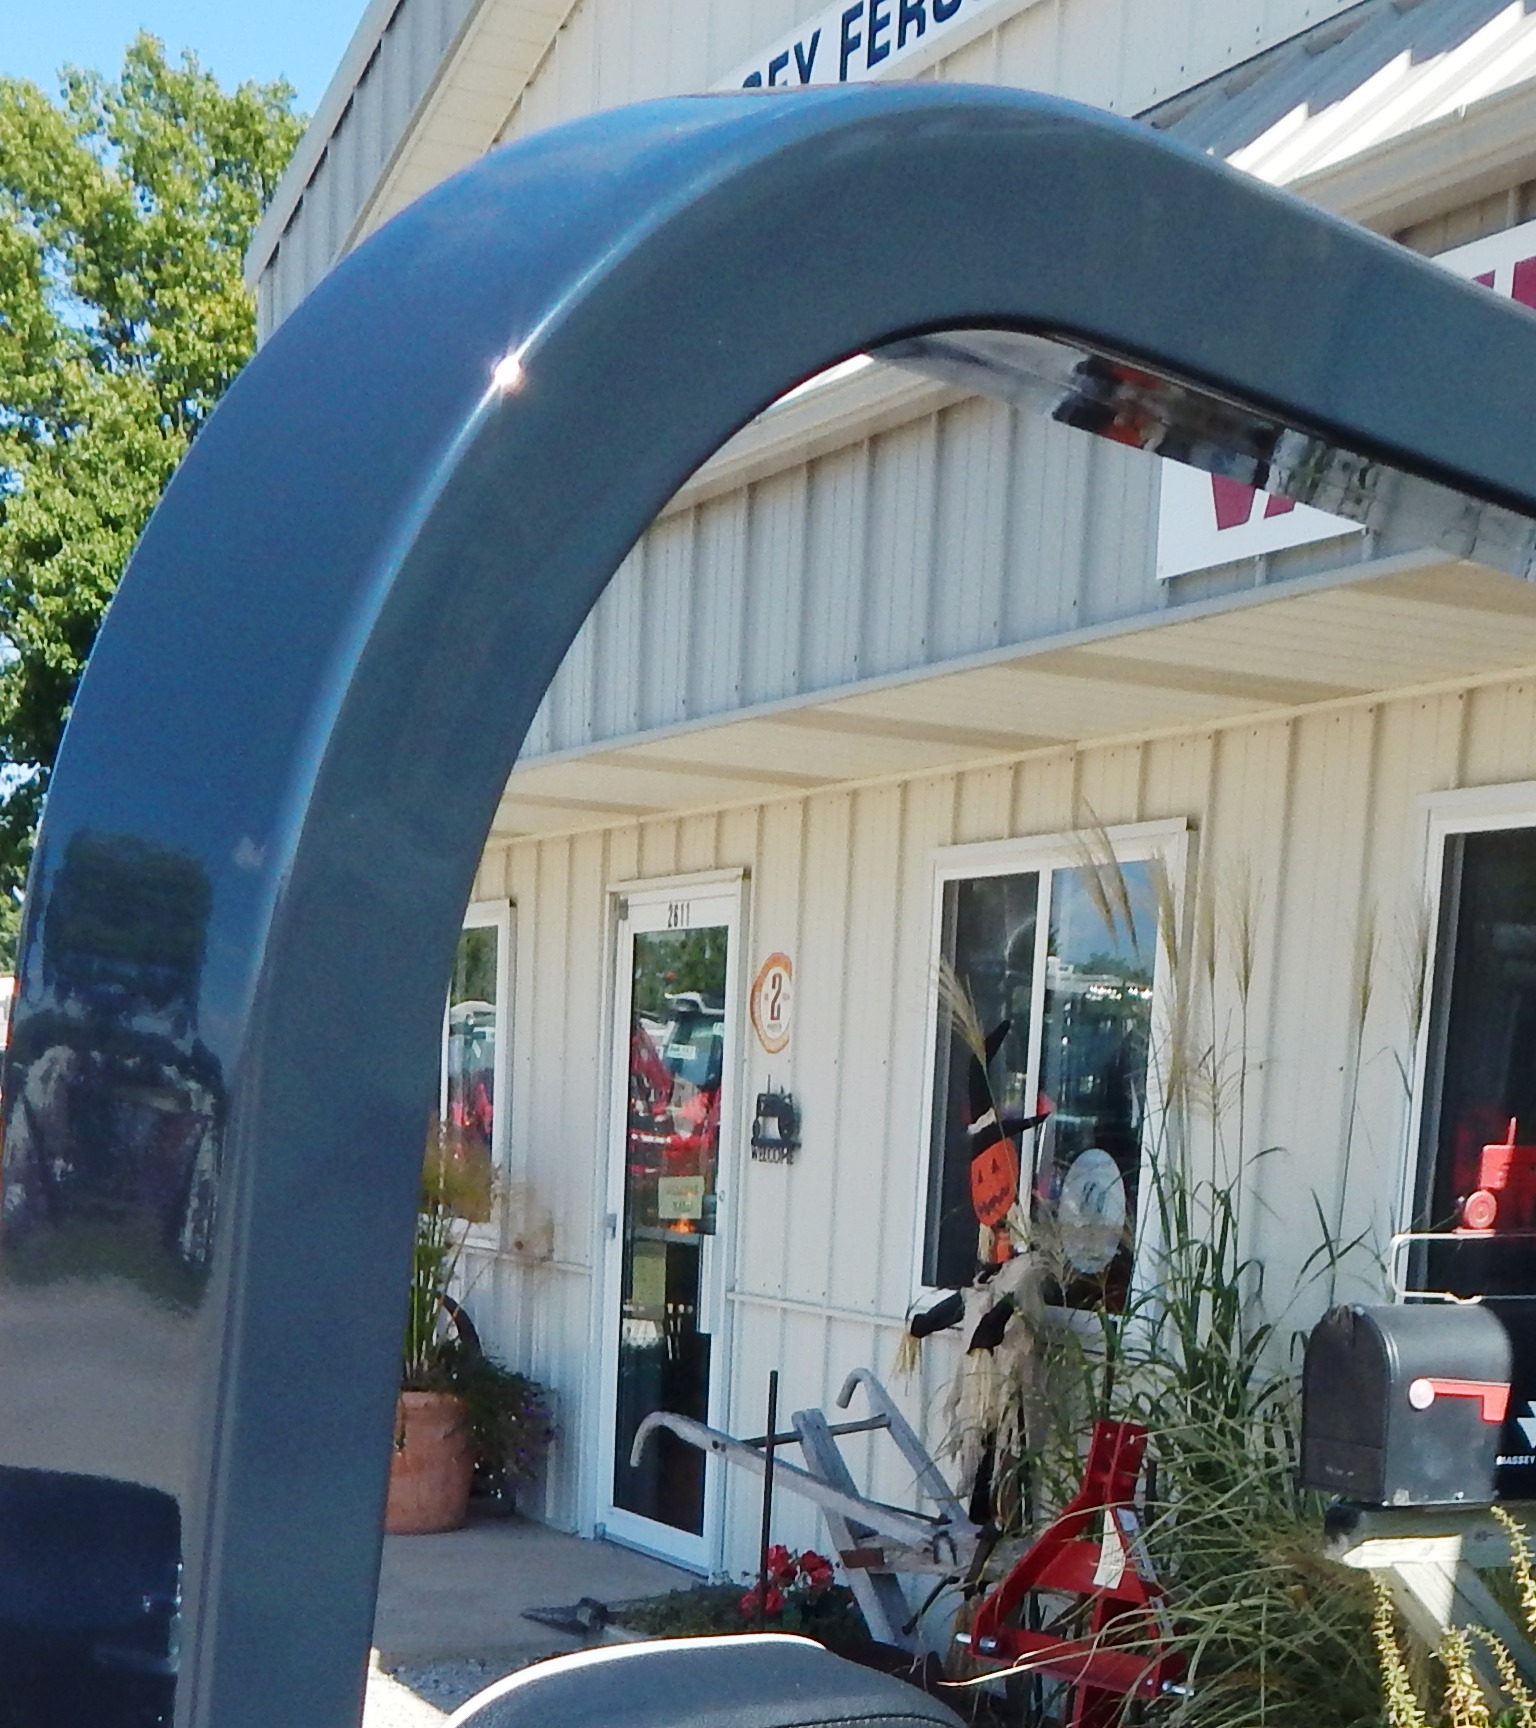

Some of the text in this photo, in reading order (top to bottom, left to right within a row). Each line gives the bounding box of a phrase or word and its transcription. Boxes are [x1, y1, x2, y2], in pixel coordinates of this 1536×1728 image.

[667, 901, 690, 928] 2611
[751, 1147, 794, 1165] WELCOME
[1496, 1455, 1535, 1466] MASSEY
